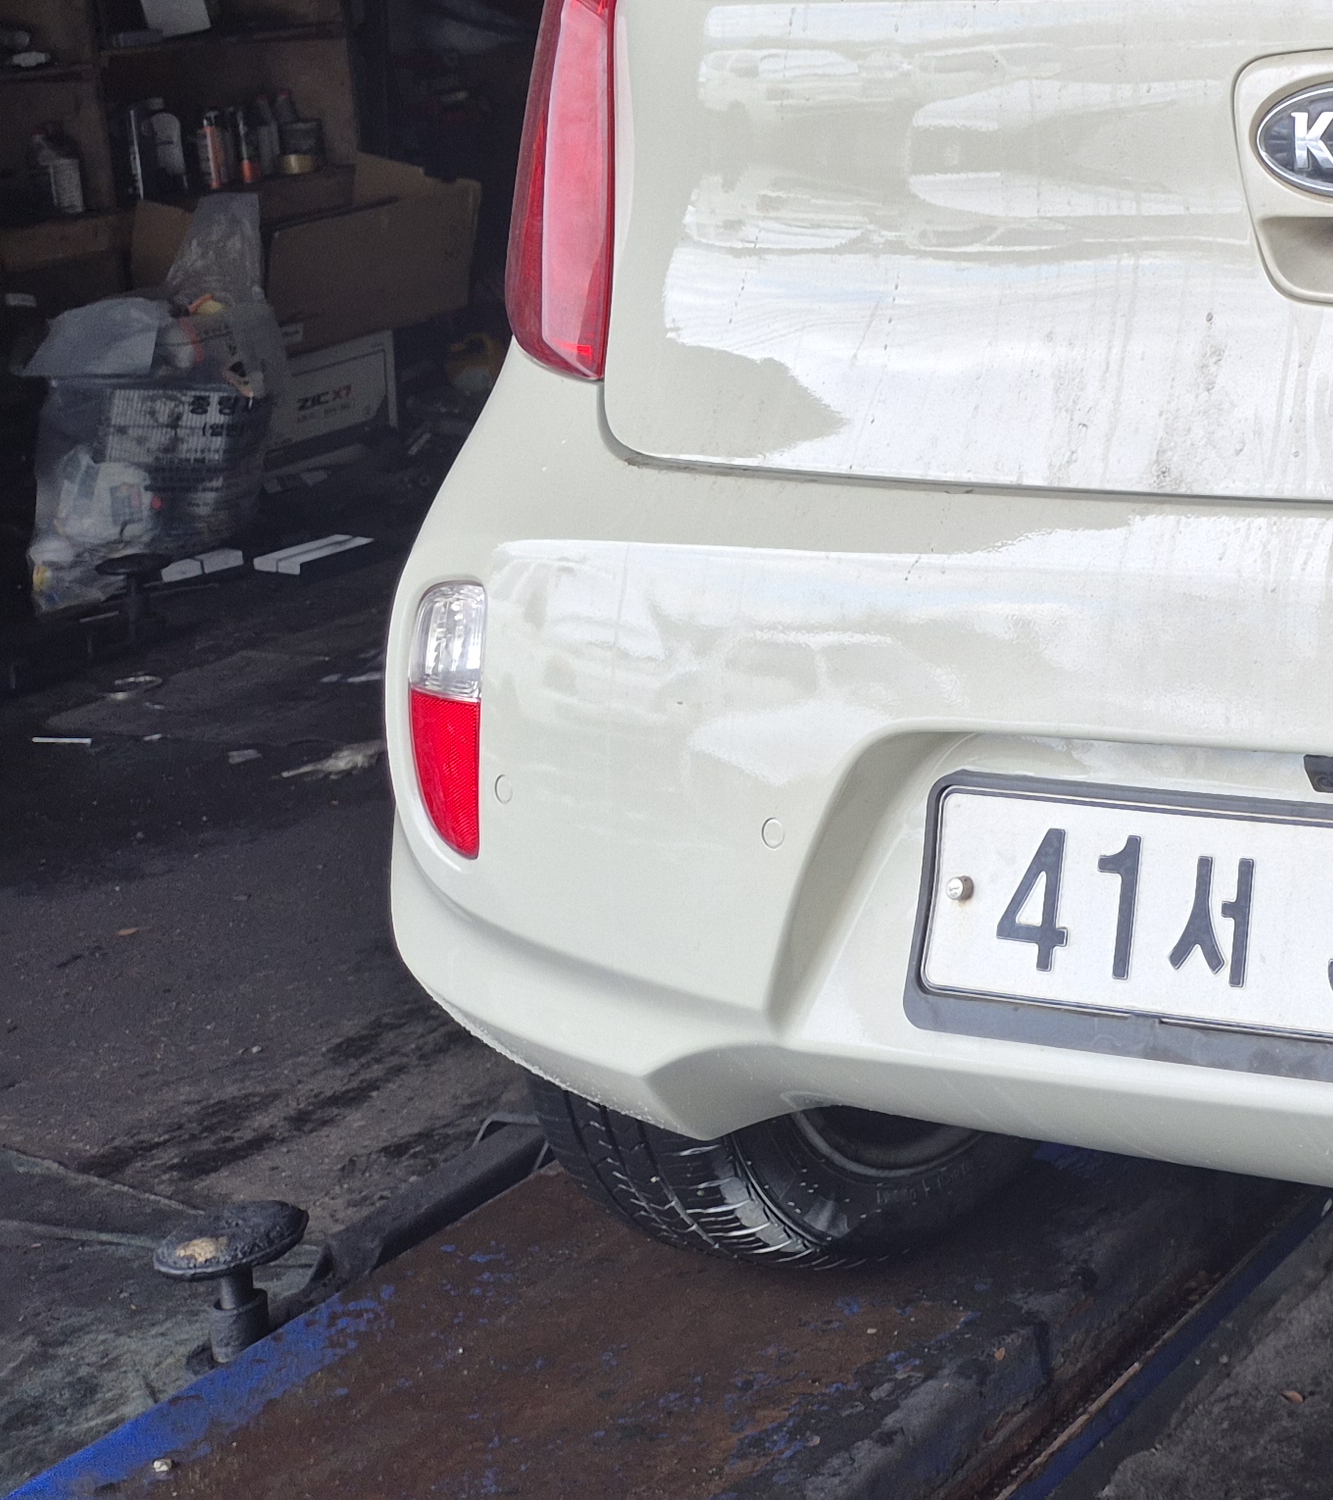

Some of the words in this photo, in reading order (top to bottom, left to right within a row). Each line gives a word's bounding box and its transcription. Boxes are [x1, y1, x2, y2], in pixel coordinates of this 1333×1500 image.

[297, 391, 329, 412] ZIC
[331, 384, 352, 402] X7
[995, 826, 1254, 989] 41서
